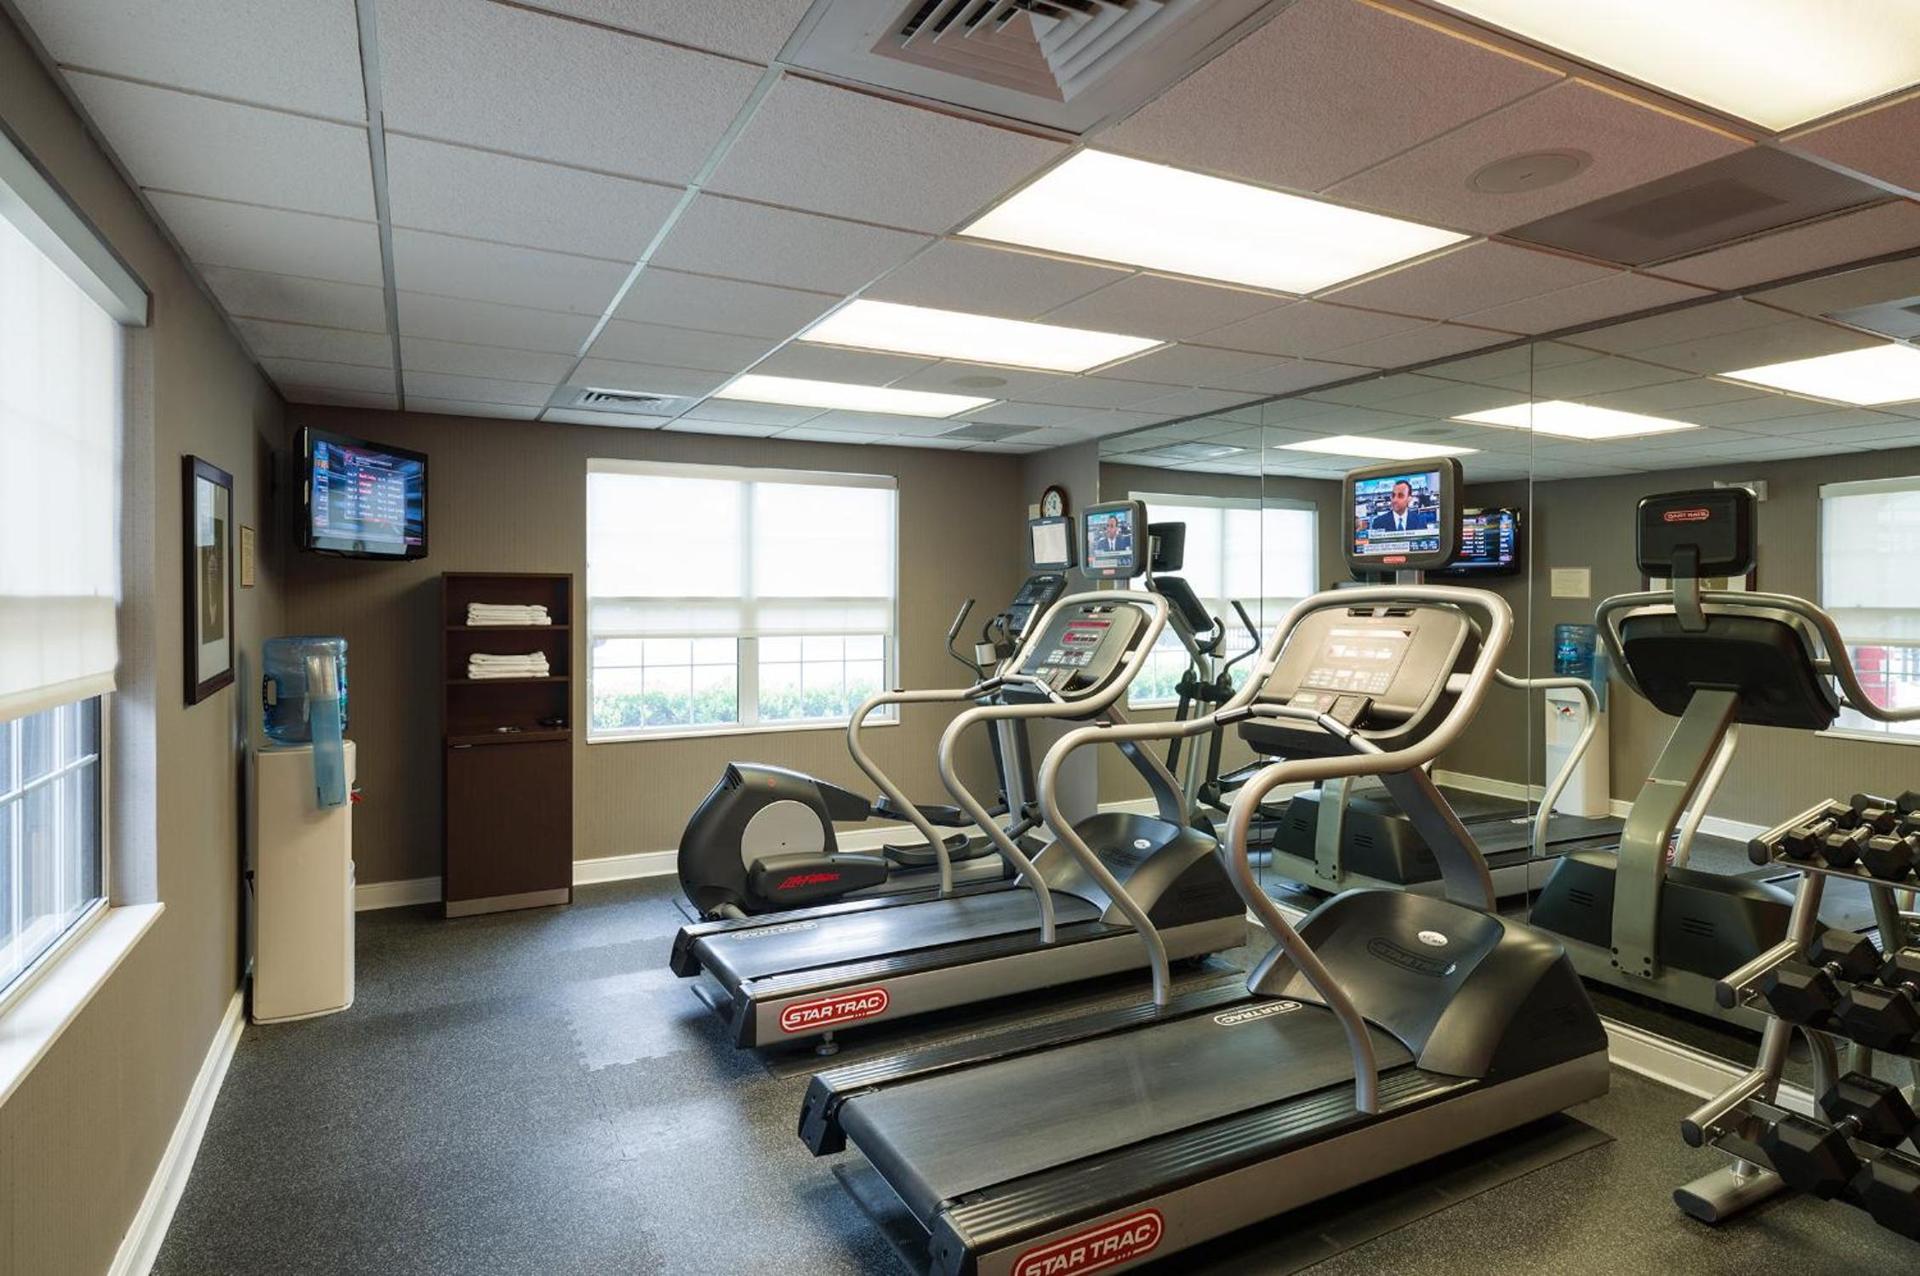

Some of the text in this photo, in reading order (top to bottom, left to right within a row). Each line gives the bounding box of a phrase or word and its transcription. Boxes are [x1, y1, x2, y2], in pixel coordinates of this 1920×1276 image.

[787, 996, 880, 1024] STAR TRAC
[1222, 1003, 1297, 1023] STAR TRAC
[1025, 1224, 1151, 1276] STAR TRAC
